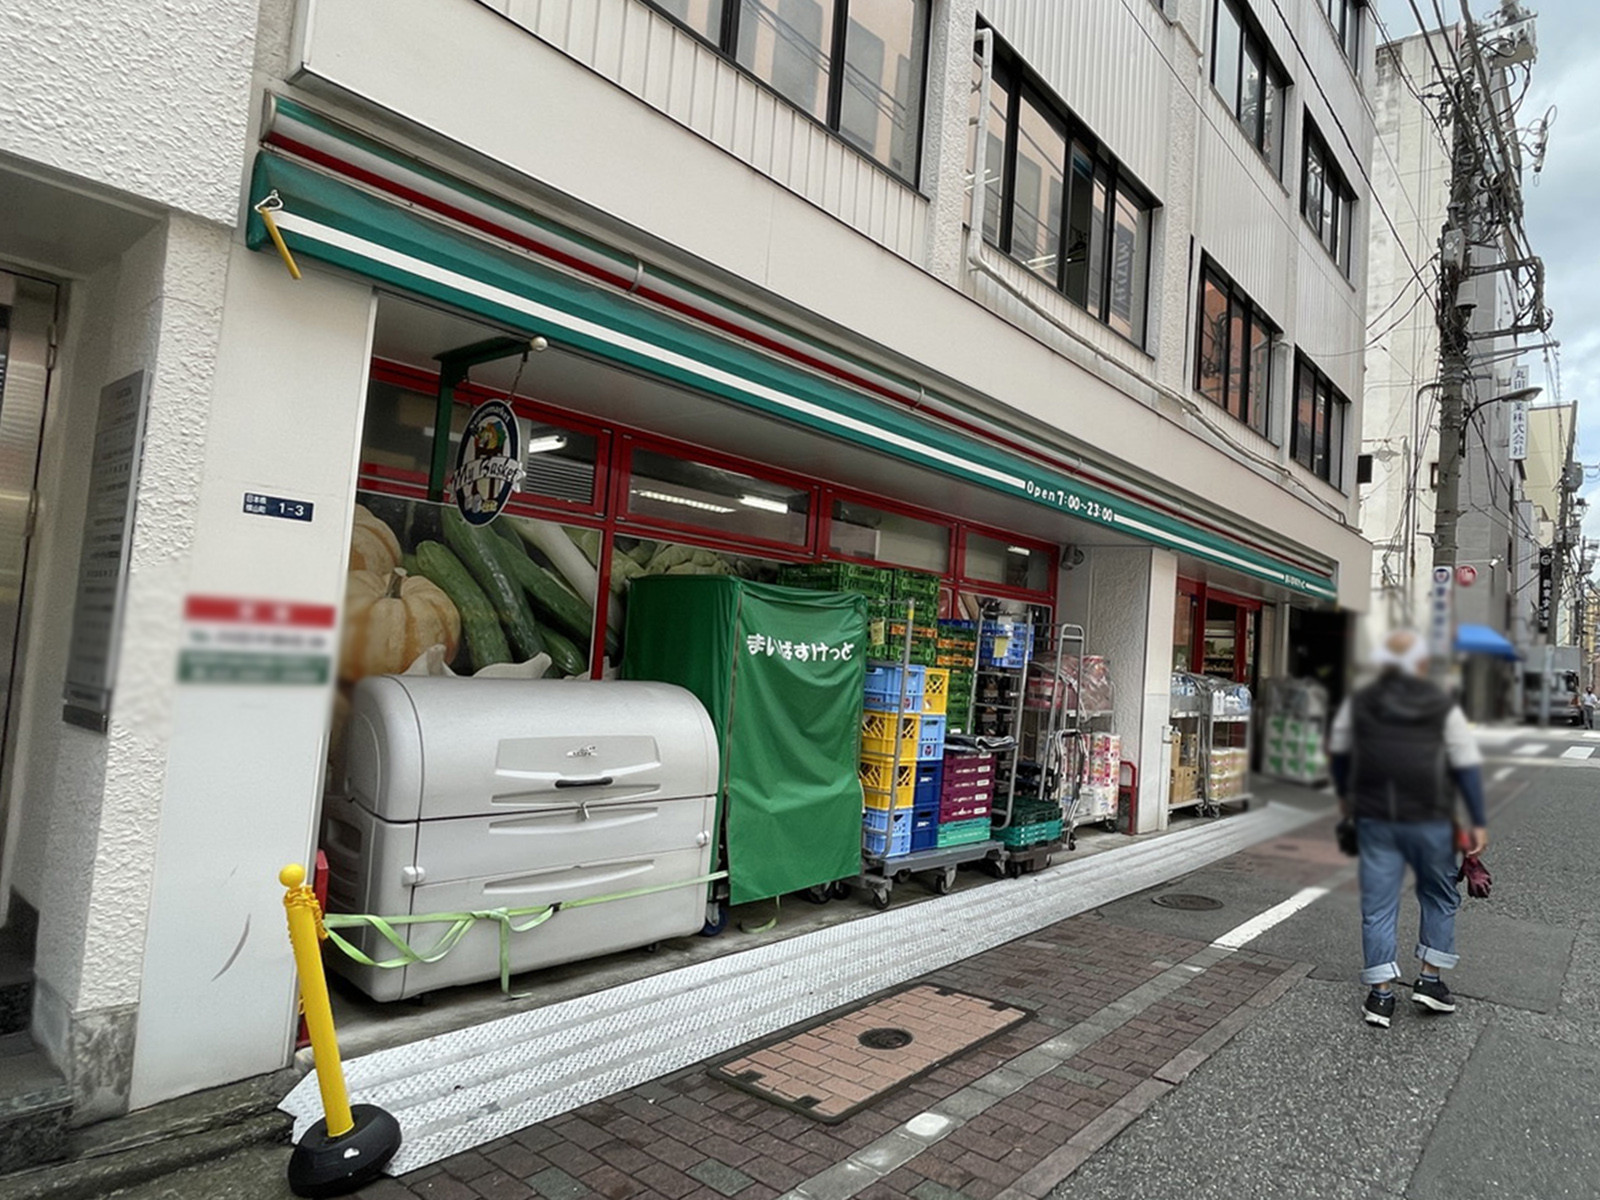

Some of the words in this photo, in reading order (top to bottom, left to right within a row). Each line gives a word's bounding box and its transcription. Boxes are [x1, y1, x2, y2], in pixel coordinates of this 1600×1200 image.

[1026, 480, 1056, 502] Open
[279, 502, 304, 516] 1-3
[746, 633, 855, 662] まいばすけっと
